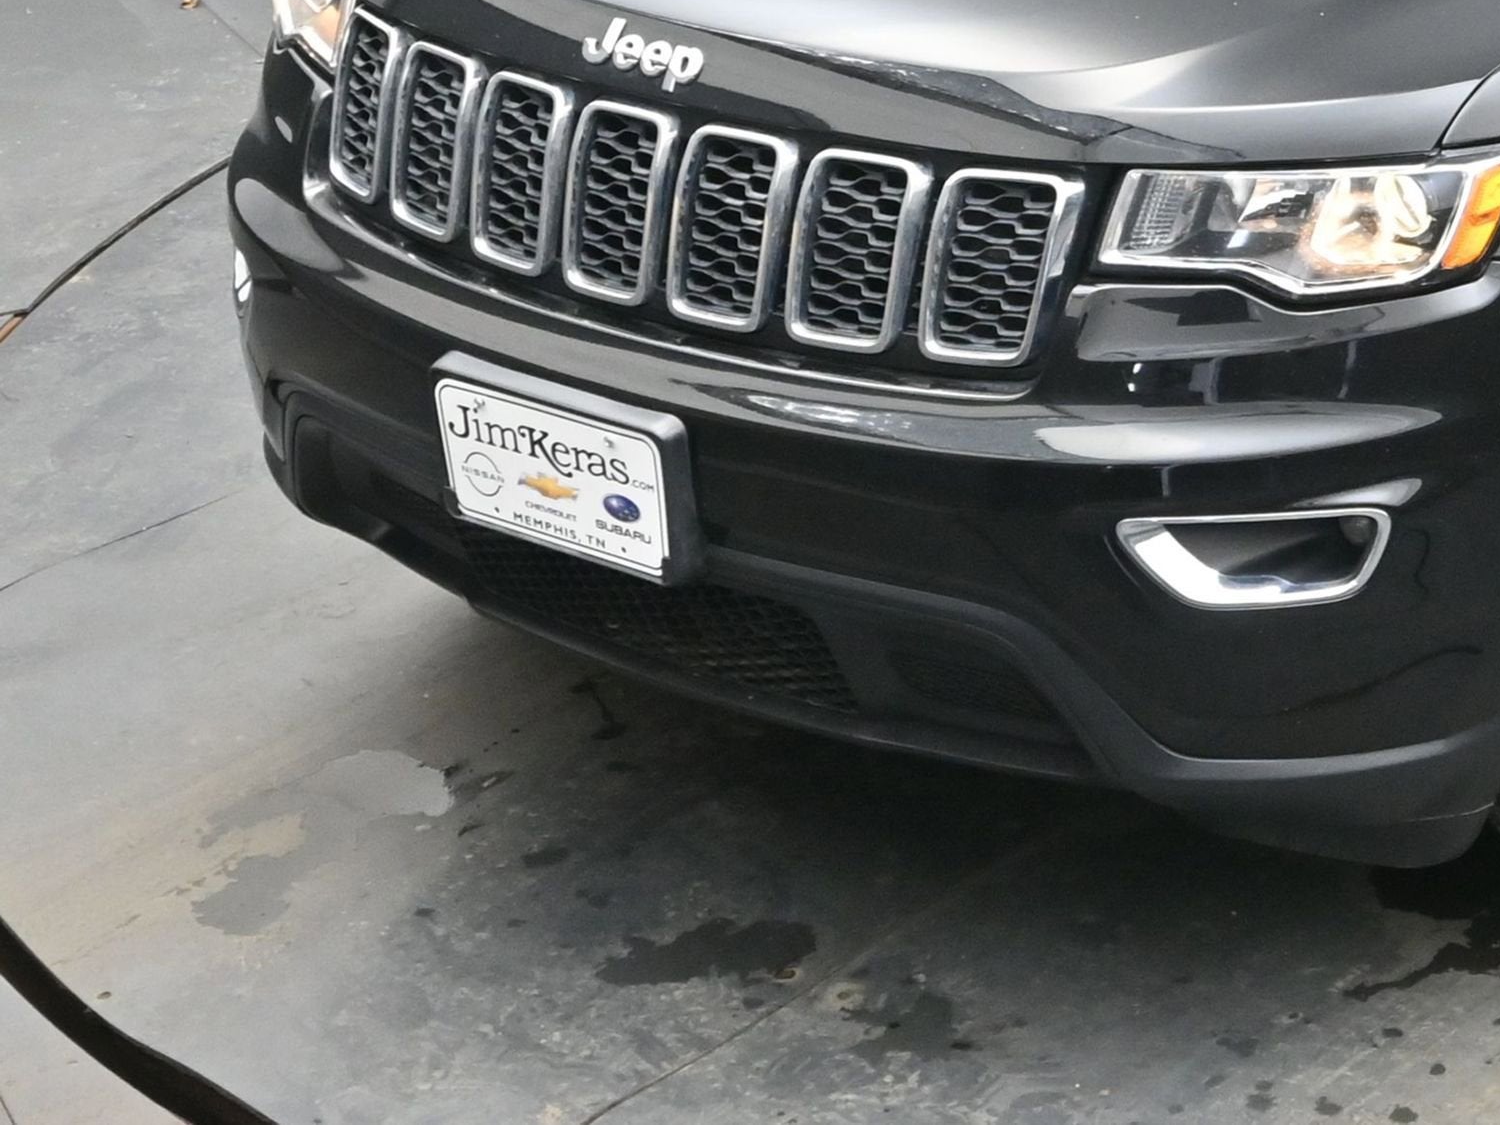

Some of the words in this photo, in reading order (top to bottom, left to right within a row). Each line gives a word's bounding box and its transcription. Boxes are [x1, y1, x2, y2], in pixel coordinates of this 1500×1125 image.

[581, 16, 704, 93] Jeep
[524, 500, 577, 522] CHEVROLET
[513, 512, 582, 542] MEMPHIS,
[586, 534, 606, 549] TN
[595, 519, 652, 545] SUBARU
